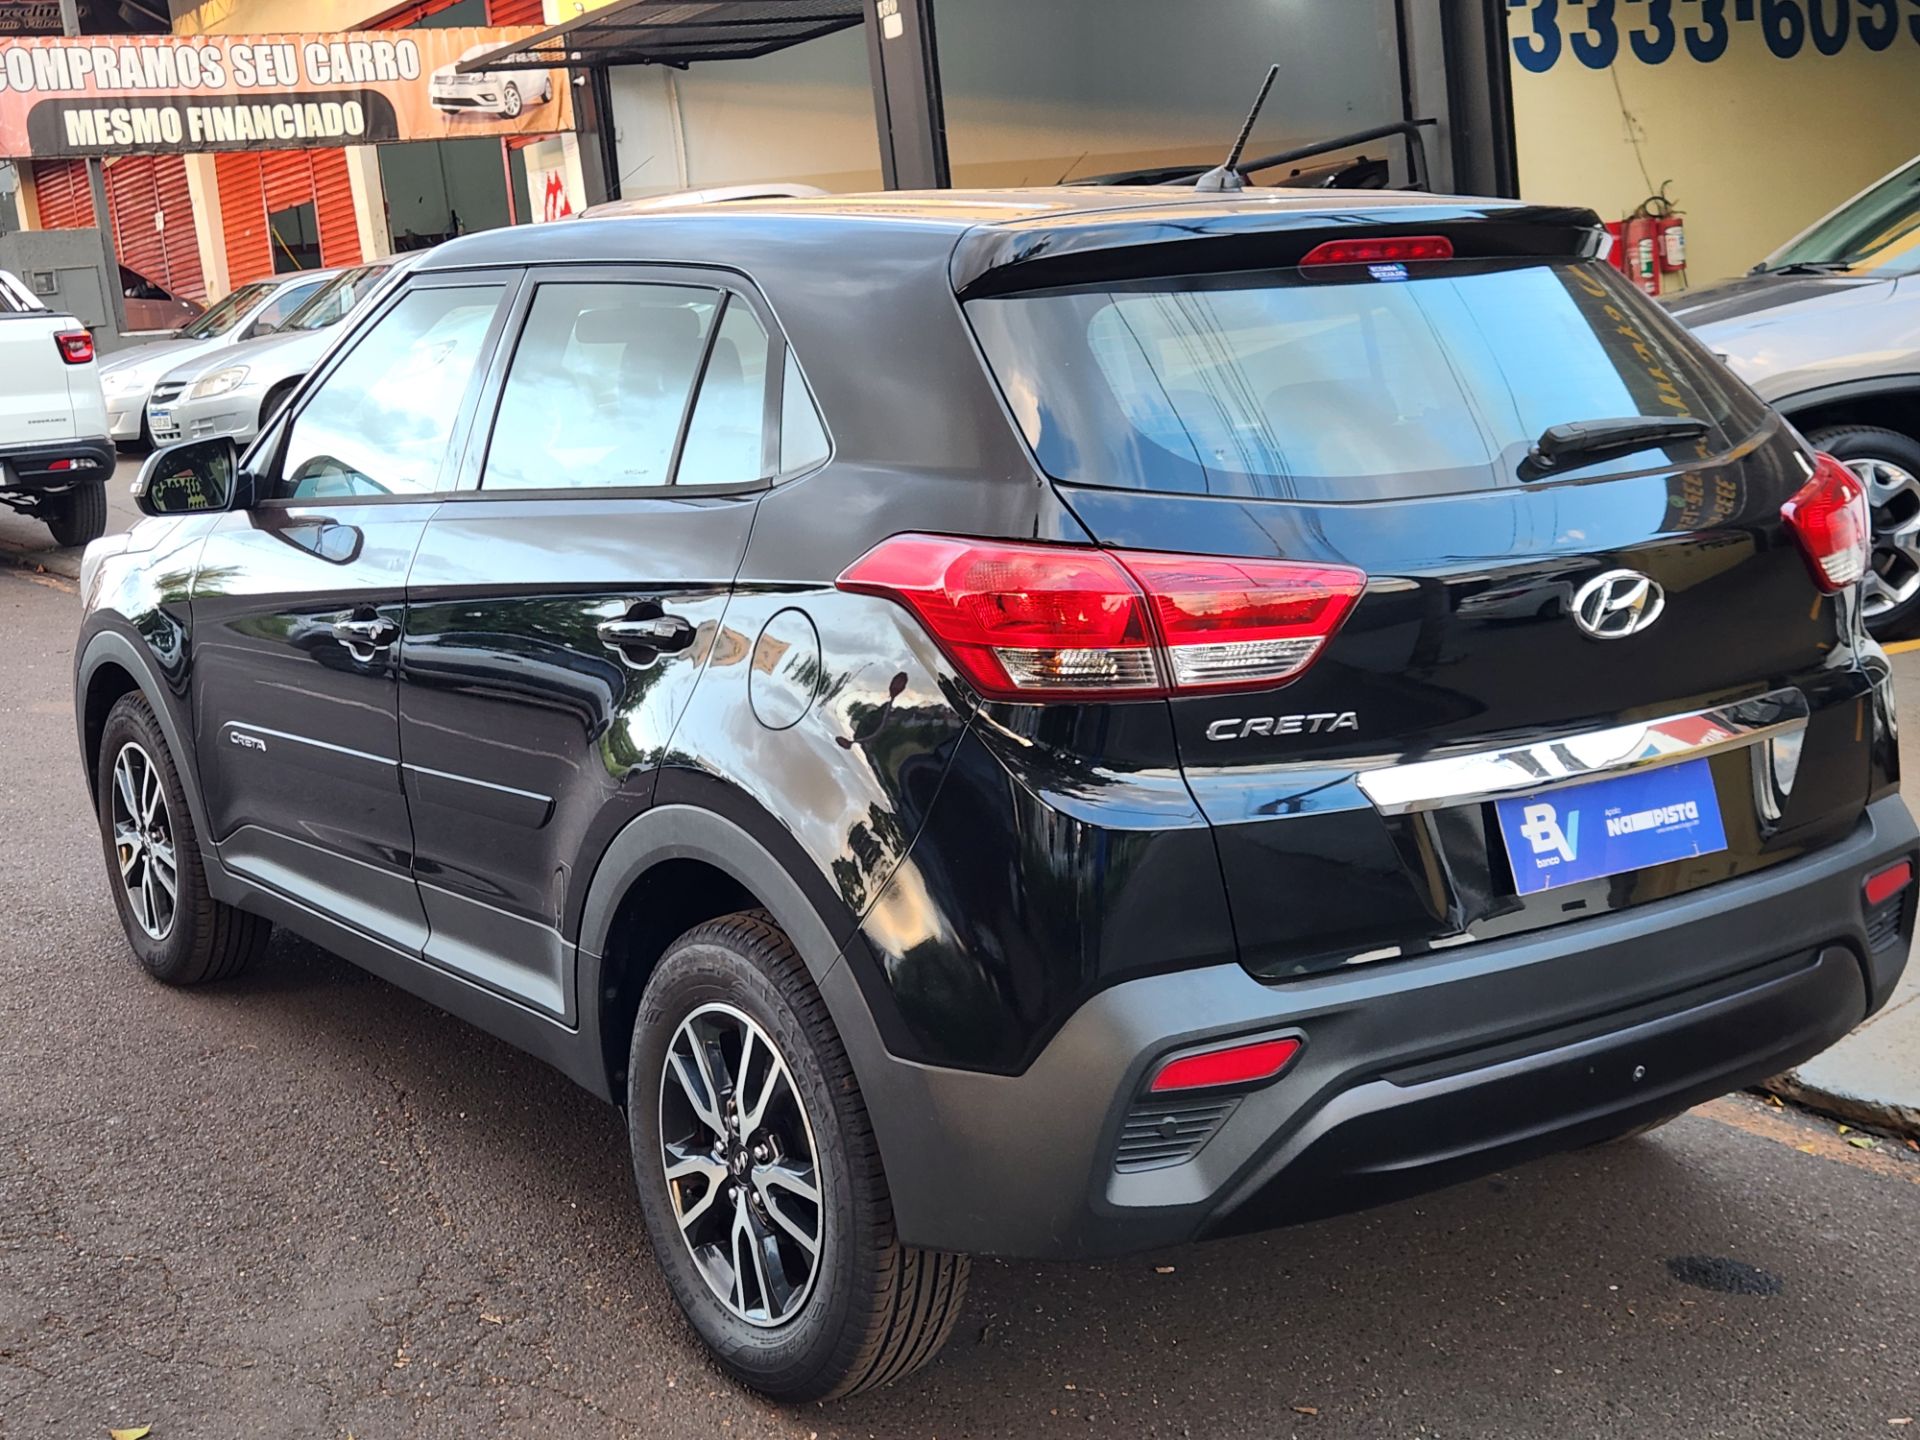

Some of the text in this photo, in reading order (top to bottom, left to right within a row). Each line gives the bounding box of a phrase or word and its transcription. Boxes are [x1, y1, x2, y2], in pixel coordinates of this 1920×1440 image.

[0, 39, 421, 93] OMPRAMOS SEU CARRO
[63, 100, 365, 147] MESMO FINANCIADO
[1205, 711, 1360, 741] CRETA
[1535, 856, 1561, 868] banco
